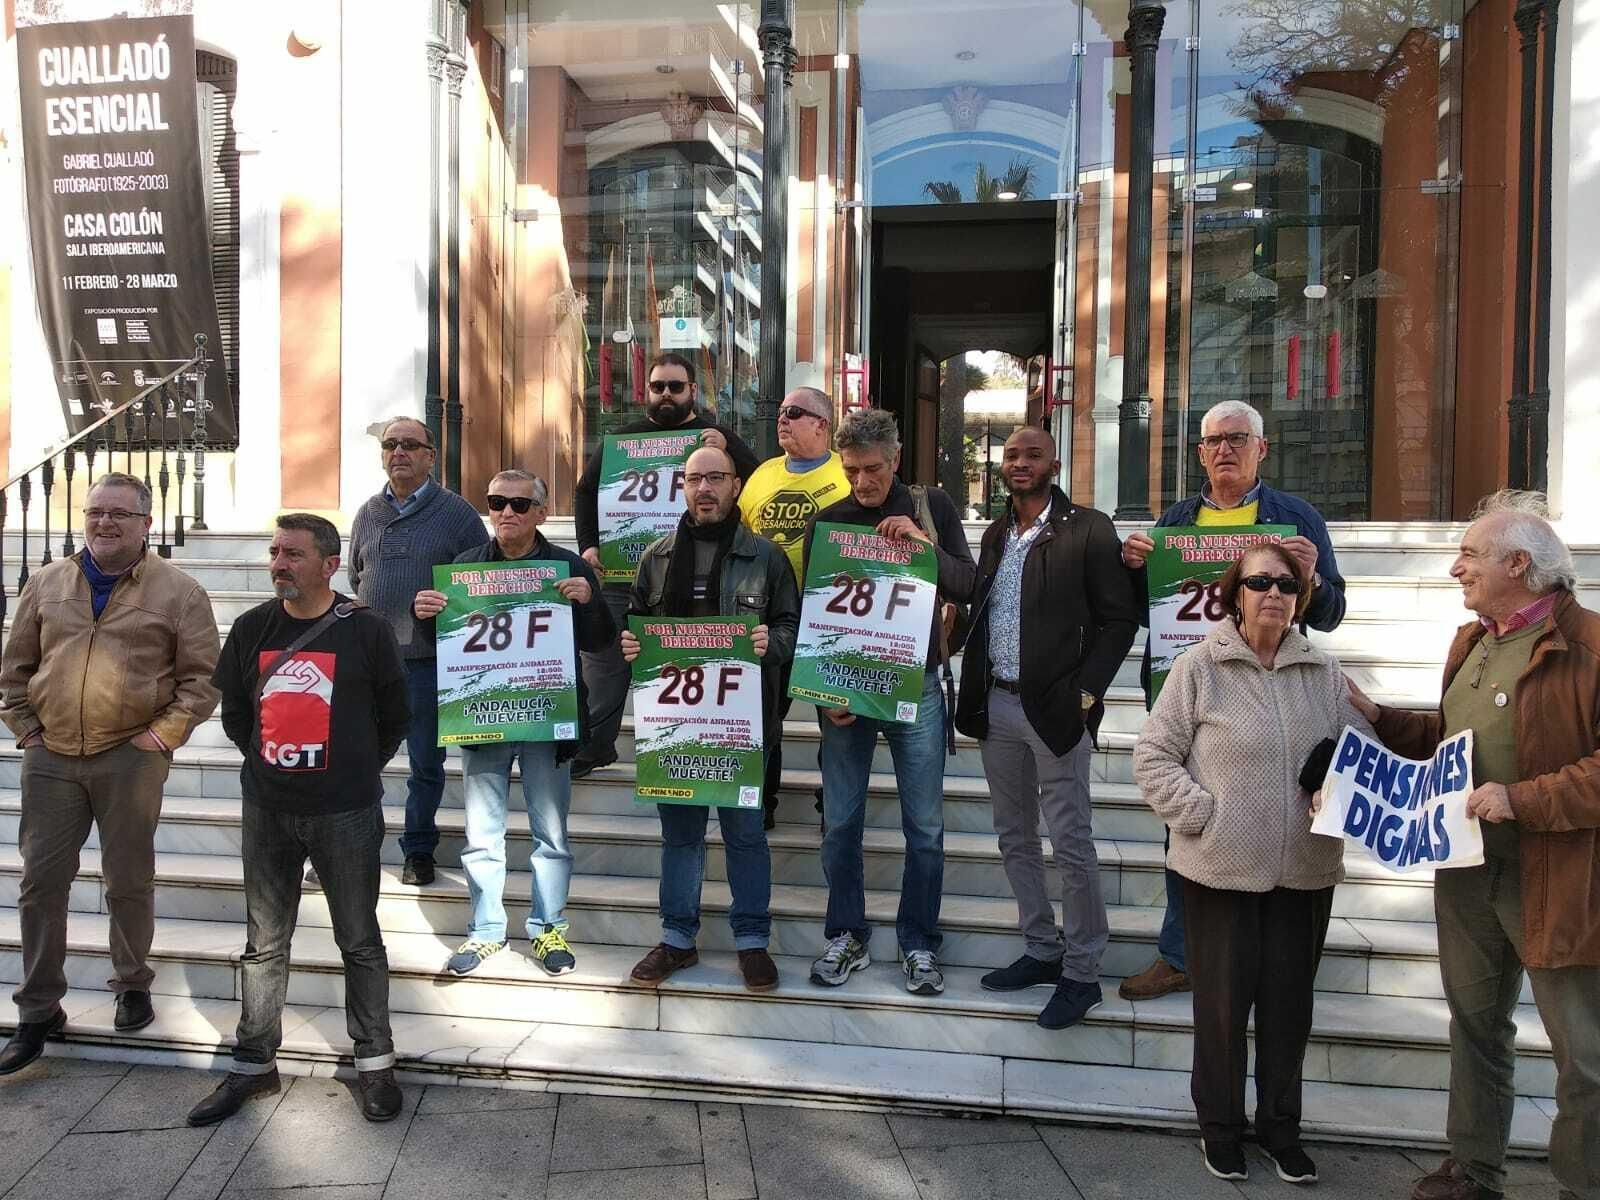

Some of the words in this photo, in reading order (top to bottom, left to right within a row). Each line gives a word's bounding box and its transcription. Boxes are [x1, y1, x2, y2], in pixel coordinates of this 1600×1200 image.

[38, 33, 170, 87] CUALLADÓ
[46, 92, 169, 137] ESENCIAL
[63, 153, 102, 170] GABRIEL
[104, 149, 154, 169] CUALLADÓ
[54, 176, 107, 194] FOTÓGRAFO
[64, 213, 106, 238] CASA
[110, 207, 163, 237] COLÓN
[66, 243, 88, 257] SALA
[89, 241, 165, 256] IBEROAMERICANA
[62, 276, 73, 290] 11
[75, 275, 119, 290] FEBRERO
[126, 275, 140, 288] 28
[142, 274, 177, 288] MARZO
[617, 440, 640, 450] POR
[641, 435, 697, 449] NUESTROS
[627, 446, 685, 458] DERECHOS
[618, 470, 659, 502] 28
[763, 502, 813, 519] STOP
[829, 531, 855, 544] POR
[1165, 535, 1197, 549] POR
[1200, 534, 1282, 548] NUESTROS
[840, 546, 912, 564] DERECHOS
[1181, 549, 1247, 562] DERECH
[452, 571, 481, 584] POR
[484, 567, 556, 582] NUESTROS
[468, 581, 542, 596] DERECHOS
[825, 574, 876, 617] 28
[885, 582, 916, 620] F
[1176, 580, 1226, 622] 28
[463, 612, 512, 653] 28
[526, 610, 552, 649] F
[644, 623, 673, 636] POR
[675, 623, 746, 636] NUESTROS
[808, 622, 873, 637] MANIFESTACIÓN
[1160, 633, 1207, 641] MANIFEST
[661, 636, 733, 649] DERECHOS
[447, 662, 518, 673] MANIFESTACIÓN
[519, 659, 562, 668] ANDALUZA
[816, 661, 904, 688] ¡ANDALUCÍA,
[658, 665, 705, 705] 28
[716, 667, 742, 705] F
[824, 674, 892, 695] MUEVETE!
[464, 696, 556, 716] ¡ANDALUCÍA,
[475, 710, 546, 725] MUEVETE!
[643, 716, 708, 725] MANIFESTACIÓN
[710, 718, 751, 726] ANDALUZA
[264, 740, 323, 768] CGT
[659, 754, 743, 771] ¡ANDALUCÍA,
[668, 767, 734, 781] MUEVETE!
[1343, 791, 1451, 867] DIGNAS
